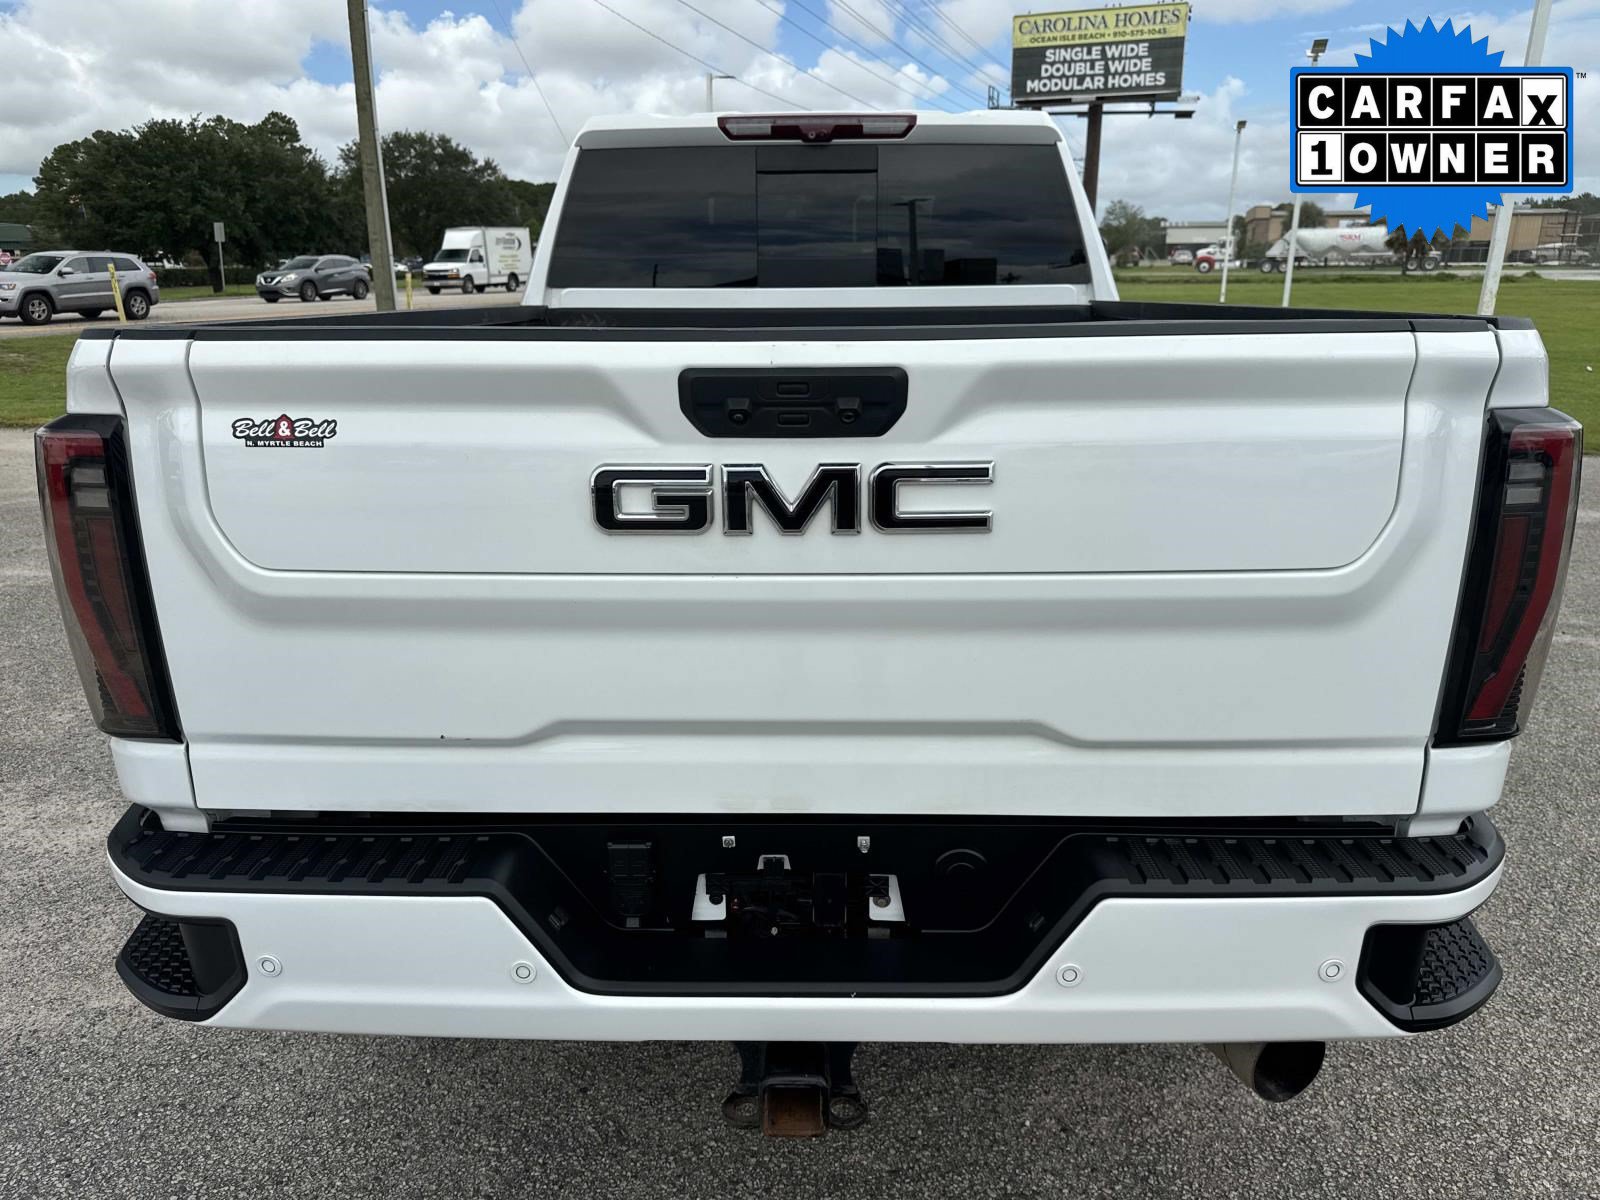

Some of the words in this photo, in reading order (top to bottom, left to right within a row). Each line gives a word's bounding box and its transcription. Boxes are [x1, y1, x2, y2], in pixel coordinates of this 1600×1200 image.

[1019, 16, 1108, 35] CAROLINA
[1115, 9, 1181, 28] HOMES
[1029, 36, 1058, 44] OCEAN
[1059, 34, 1076, 42] ISLE
[1078, 33, 1106, 41] BEACH
[1045, 48, 1101, 62] SINGLE
[1105, 43, 1149, 58] WIDE
[1041, 61, 1105, 77] DOUBLE
[1108, 58, 1152, 72] WIDE
[1026, 77, 1104, 93] MODULAR
[1107, 73, 1166, 88] HOMES
[234, 420, 276, 437] Bell
[278, 420, 291, 437] &
[293, 420, 336, 438] Bell
[590, 462, 995, 536] GMC
